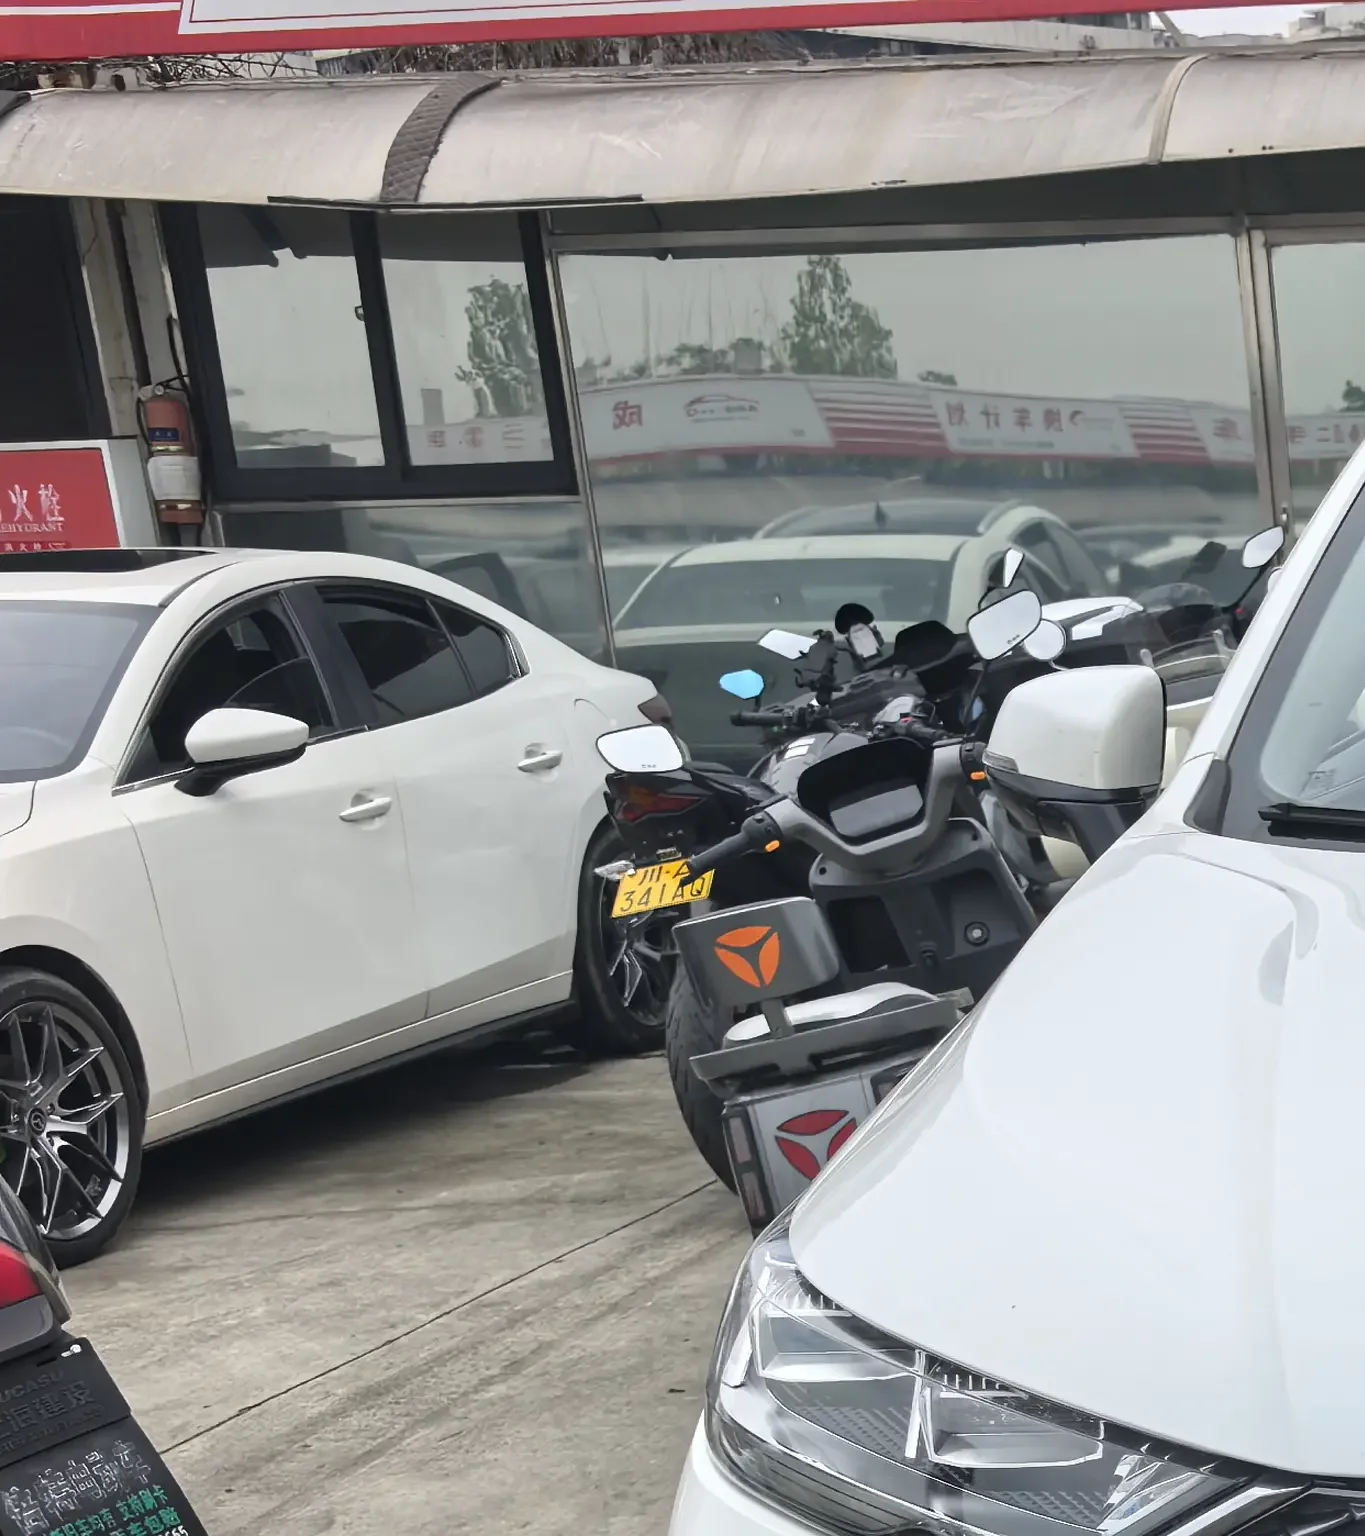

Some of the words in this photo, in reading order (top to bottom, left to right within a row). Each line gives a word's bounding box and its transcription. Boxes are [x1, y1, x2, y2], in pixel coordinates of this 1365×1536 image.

[0, 484, 65, 521] 火栓
[0, 523, 64, 533] EHYDRANT
[619, 876, 706, 912] 341AQ
